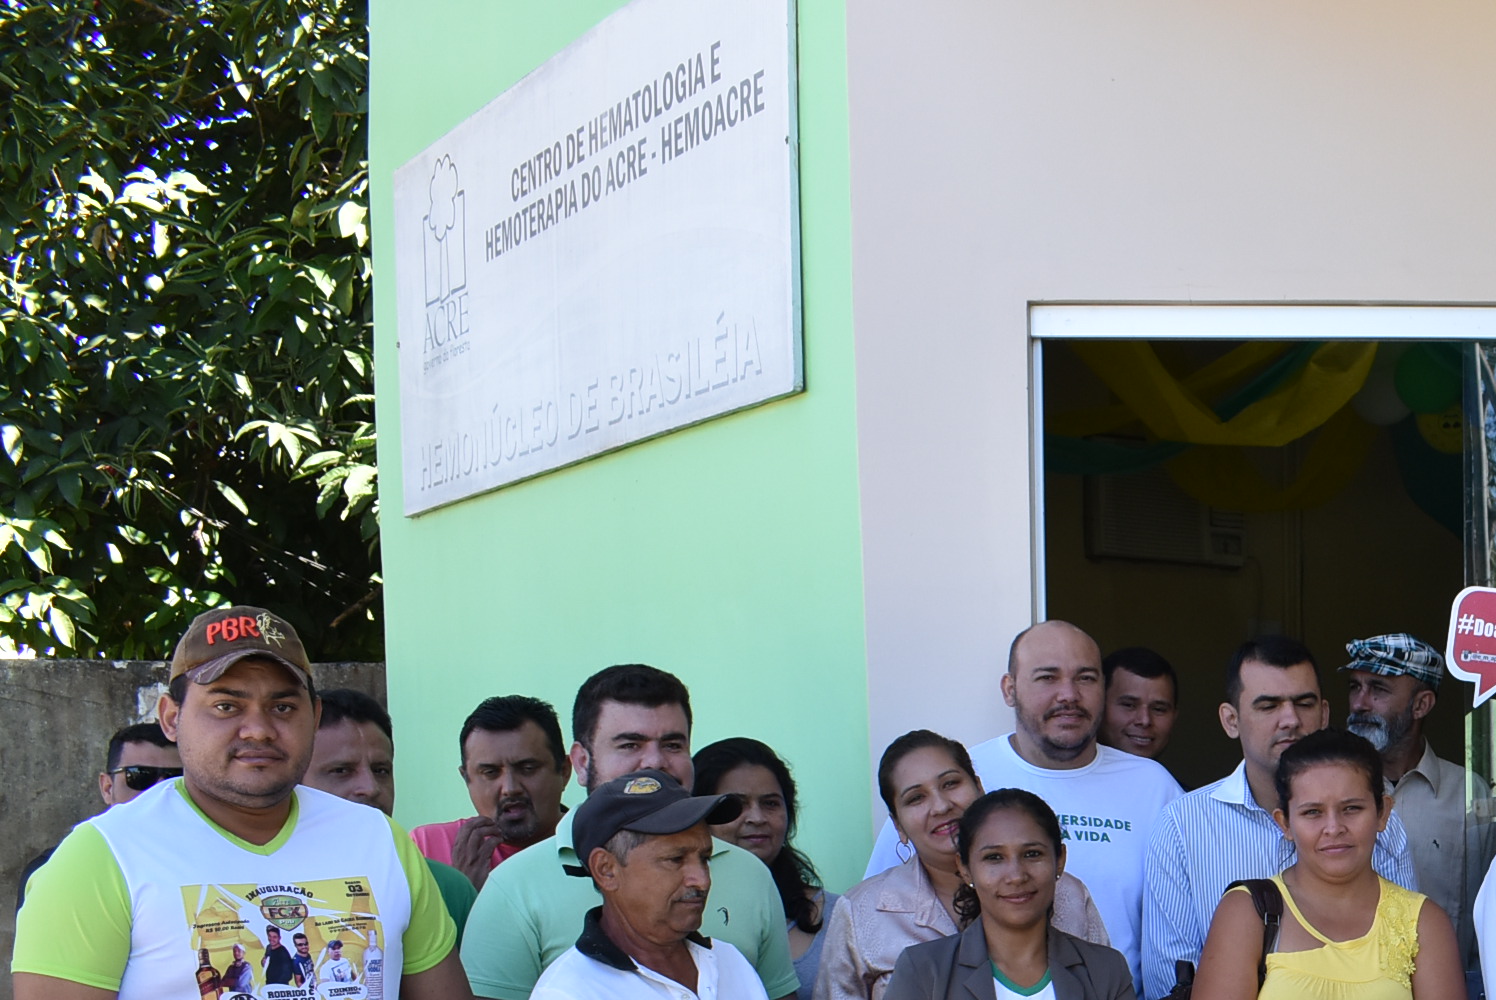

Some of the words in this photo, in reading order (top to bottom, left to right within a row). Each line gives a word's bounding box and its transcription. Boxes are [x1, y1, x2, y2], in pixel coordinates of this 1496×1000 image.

[511, 141, 562, 202] CENTRO
[566, 125, 585, 169] DE
[588, 52, 706, 156] HEMATOLOGIA
[710, 40, 721, 84] E
[485, 179, 578, 263] HEMOTERAPIA
[581, 164, 601, 209] DO
[605, 136, 647, 196] ACRE
[661, 69, 765, 164] HEMOACRE
[424, 292, 469, 354] ACRE
[421, 400, 560, 491] HEMONÚCLEO
[568, 381, 600, 440] DE
[608, 311, 763, 425] BRASILÉIA
[206, 616, 260, 645] PBR
[1074, 830, 1111, 843] VIDA
[267, 990, 306, 998] RODRIGO
